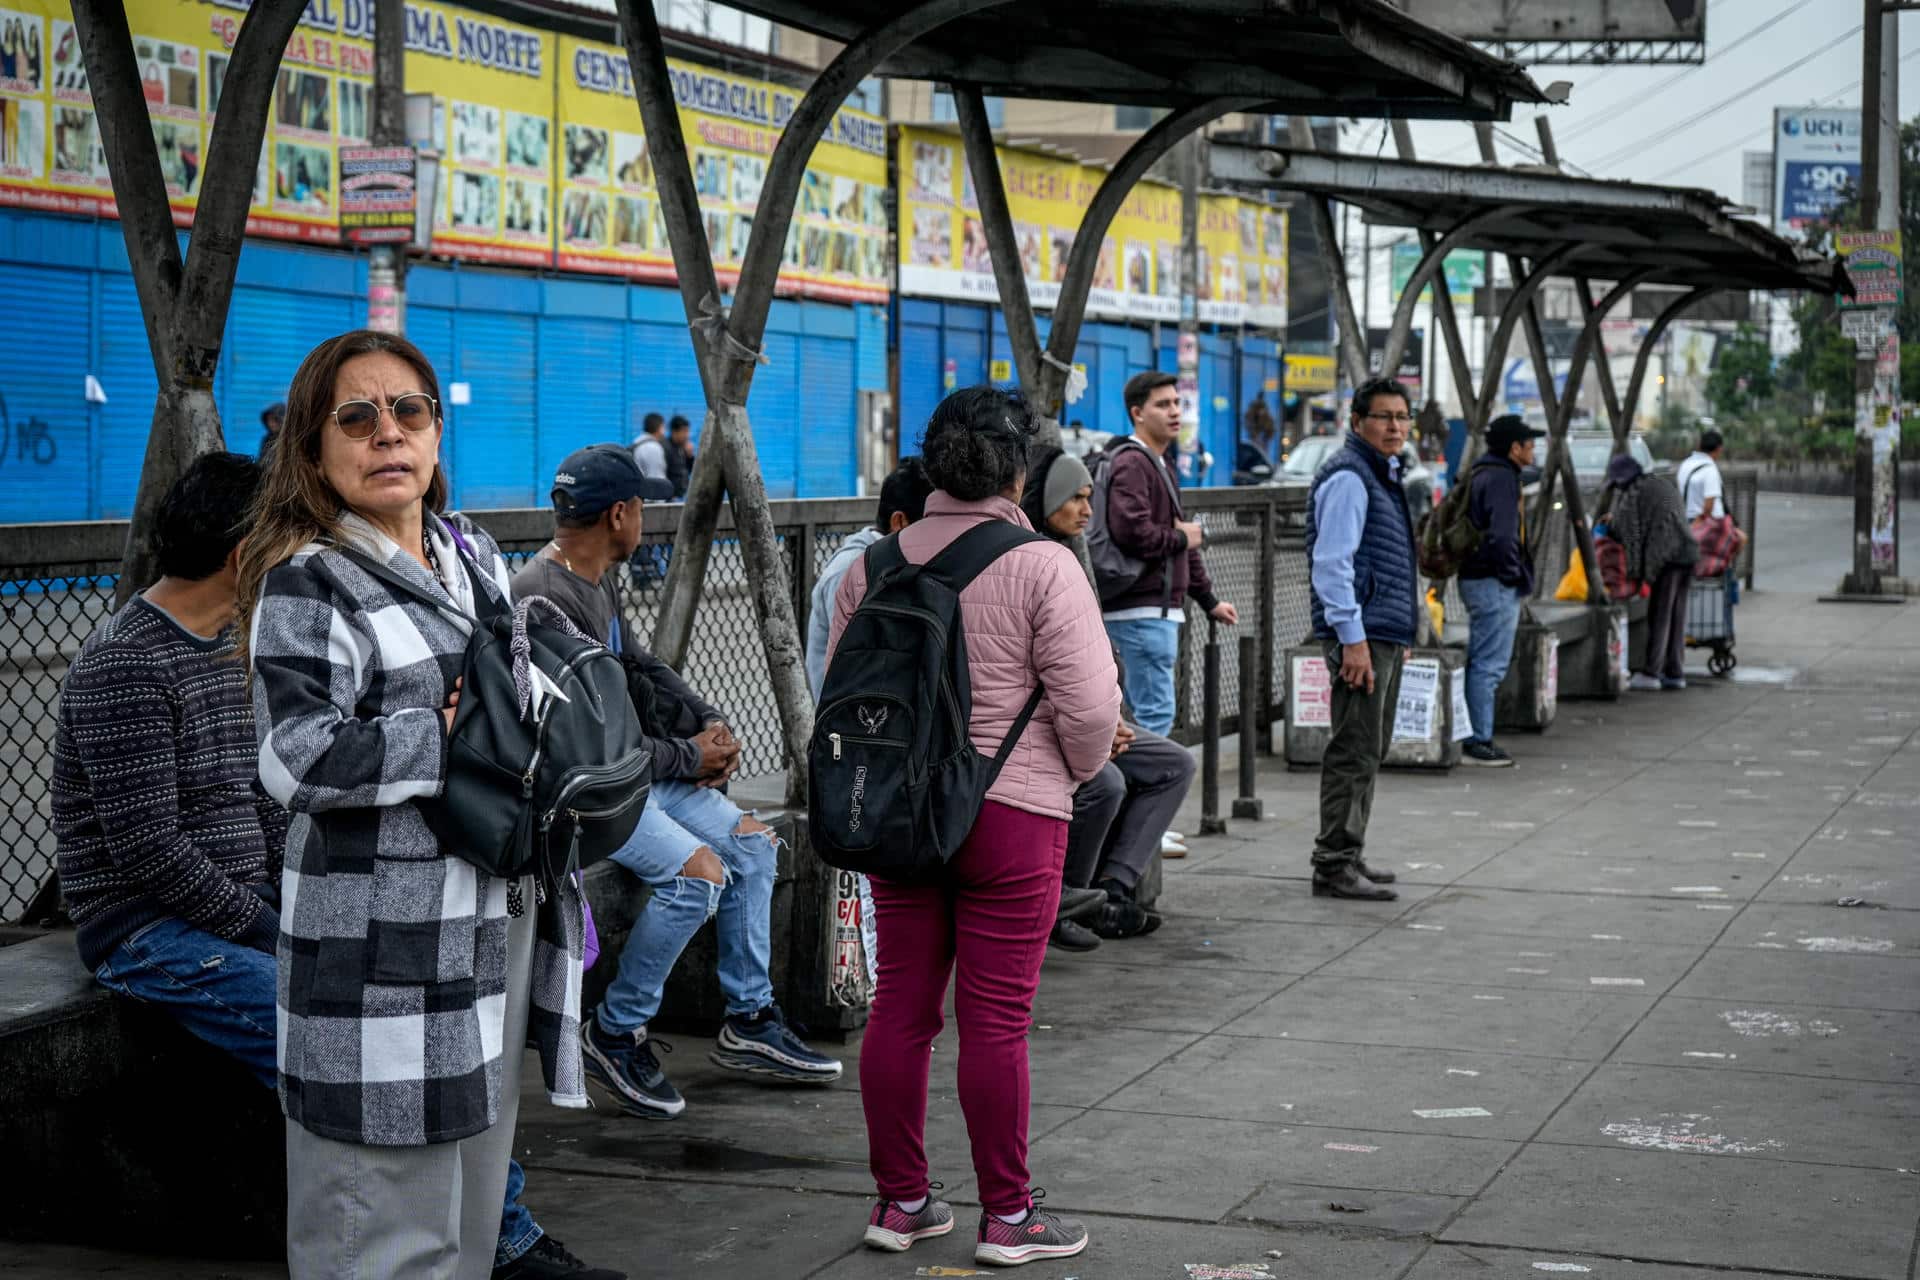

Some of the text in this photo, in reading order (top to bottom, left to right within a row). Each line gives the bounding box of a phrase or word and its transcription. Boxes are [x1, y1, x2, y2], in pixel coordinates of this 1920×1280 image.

[312, 36, 337, 69] EL
[455, 15, 541, 78] NORTE
[667, 66, 769, 127] OMERCIAL
